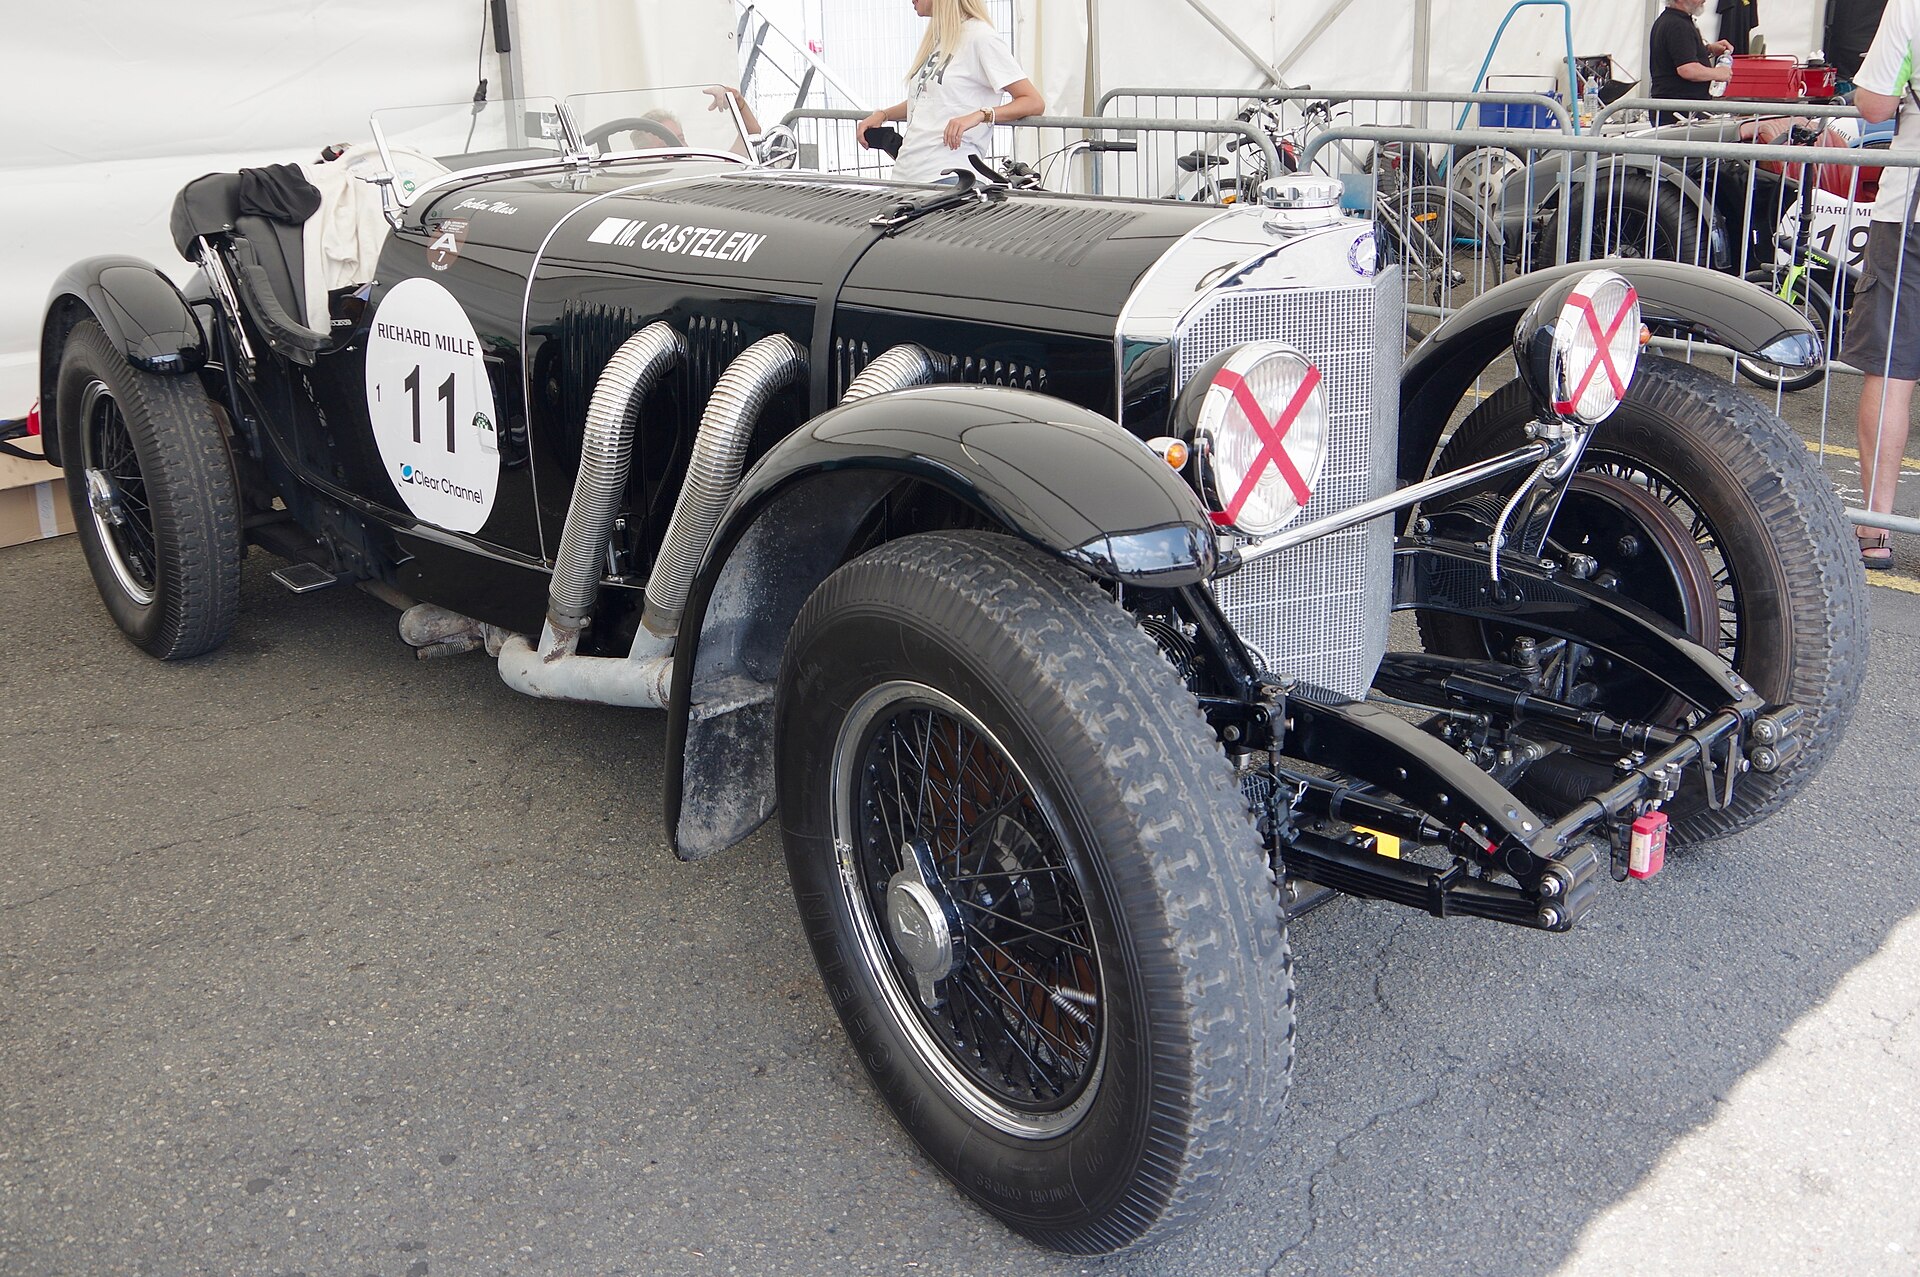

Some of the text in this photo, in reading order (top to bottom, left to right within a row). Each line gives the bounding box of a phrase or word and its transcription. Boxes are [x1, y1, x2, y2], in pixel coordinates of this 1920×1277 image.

[430, 232, 457, 252] A
[614, 220, 767, 262] M. CASTELEIN
[1817, 224, 1870, 266] 19
[377, 322, 475, 356] RICHARD MILLE
[375, 383, 381, 402] 1
[404, 365, 455, 453] 11
[414, 470, 484, 504] Clear Channel
